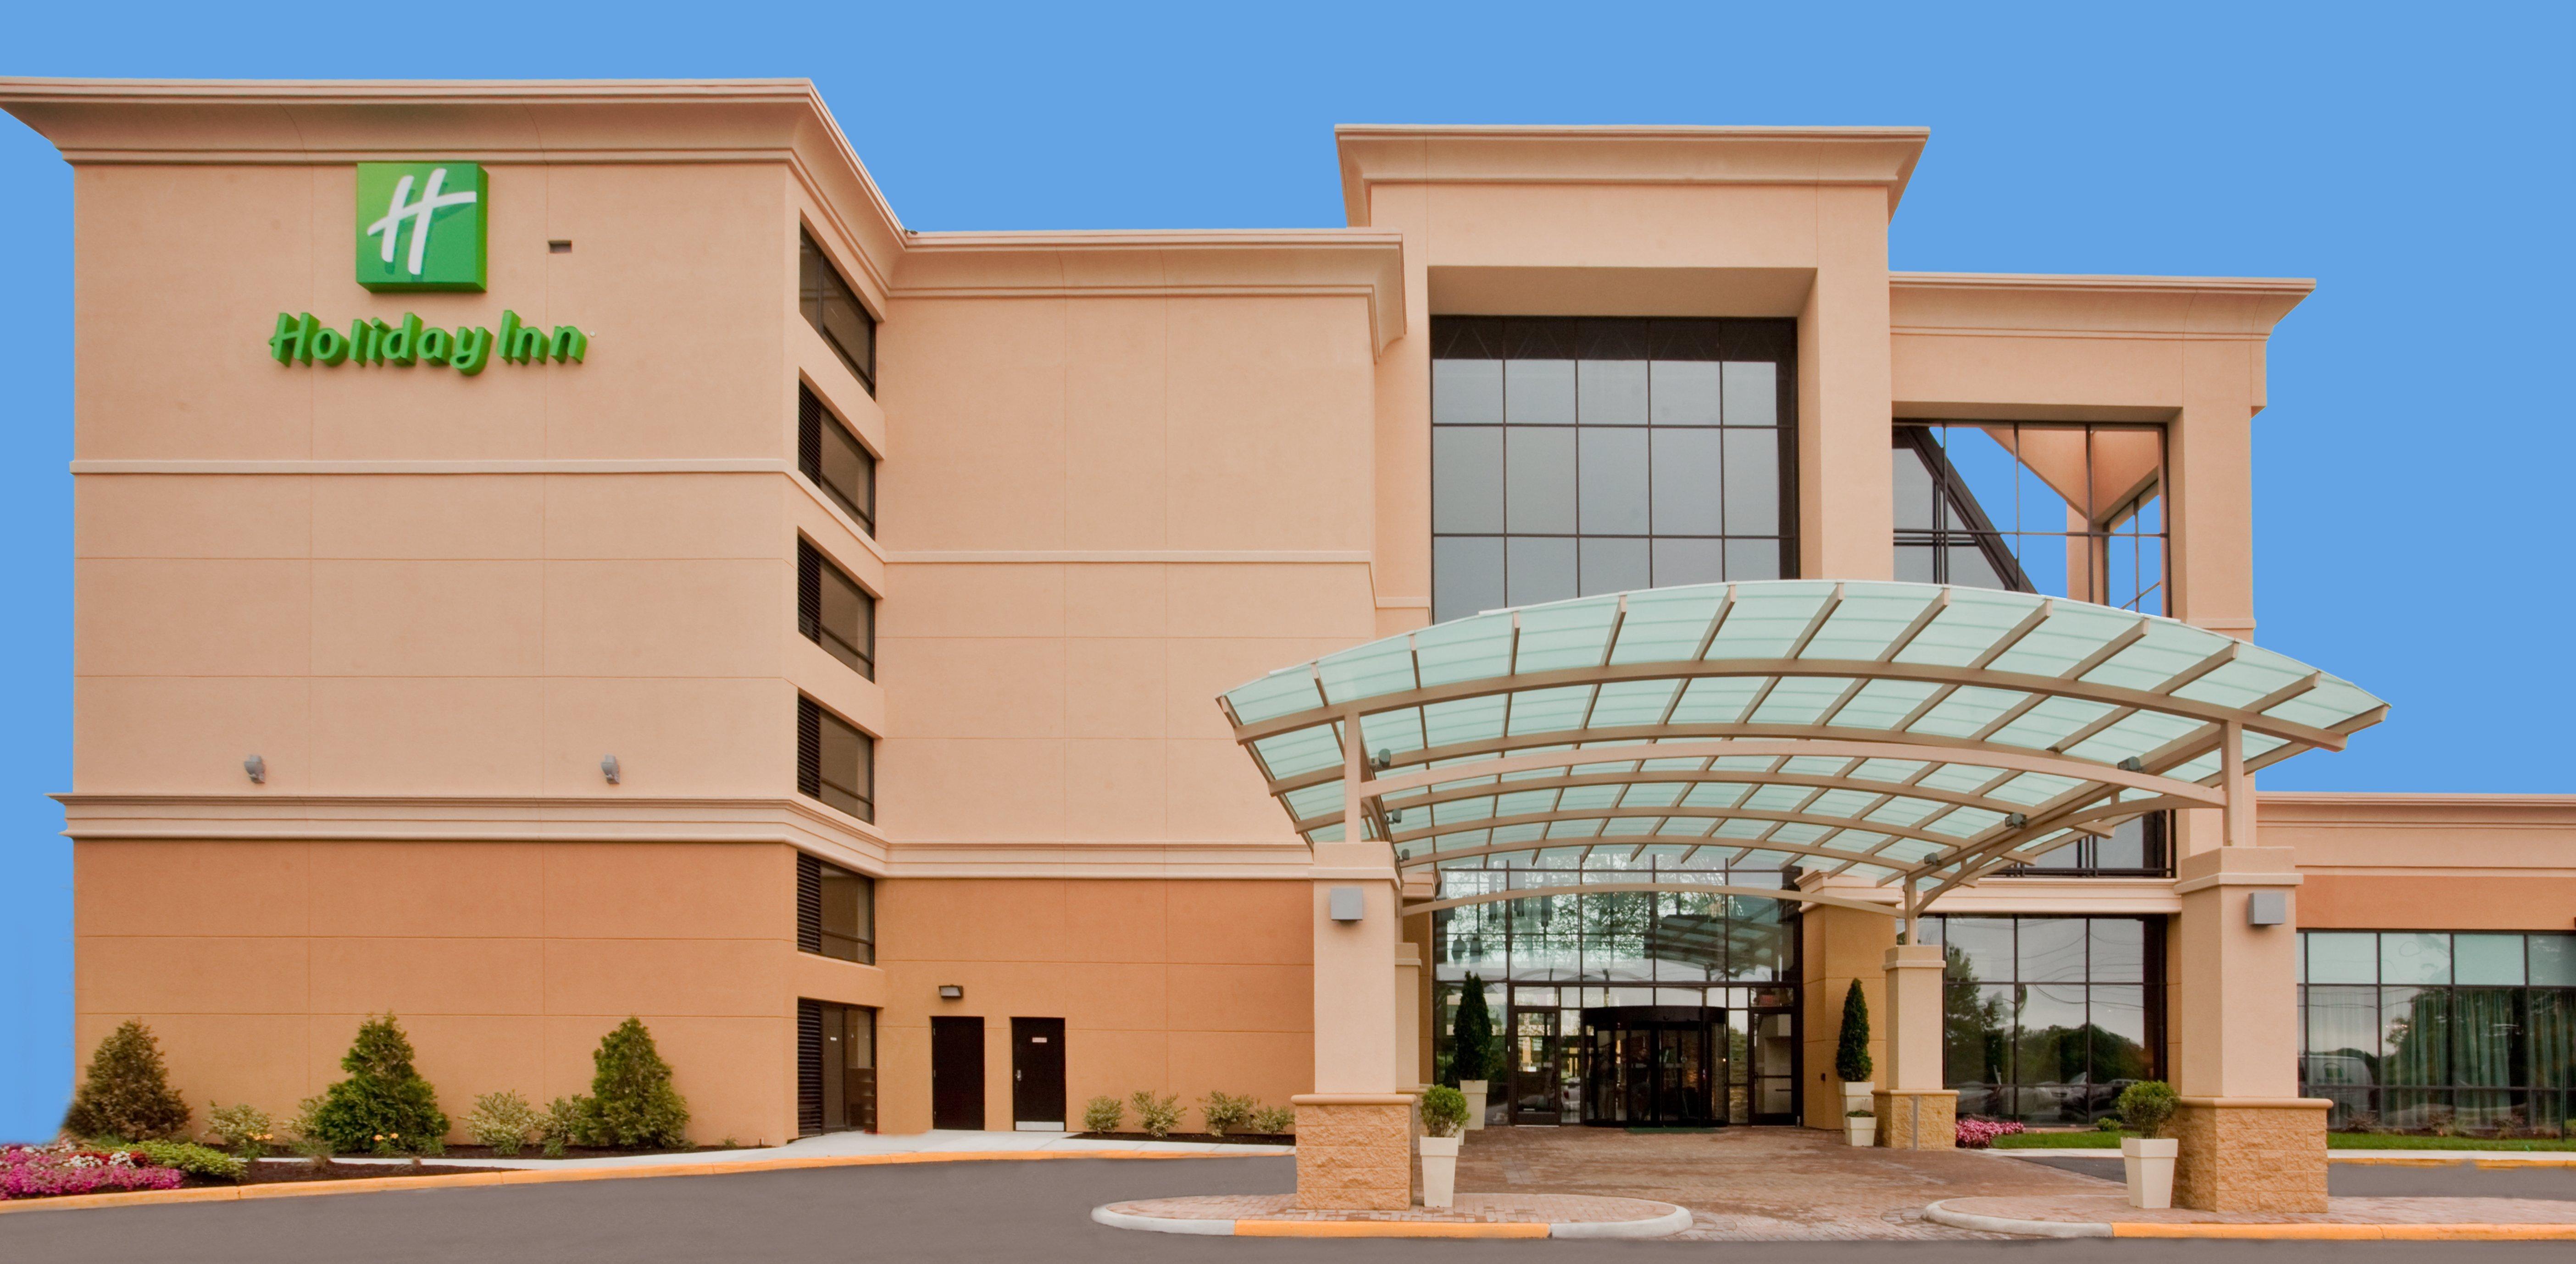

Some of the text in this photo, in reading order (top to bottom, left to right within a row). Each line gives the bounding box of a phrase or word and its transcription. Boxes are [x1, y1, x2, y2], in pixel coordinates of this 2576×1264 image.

[367, 168, 477, 275] H
[269, 310, 588, 376] Holiday Inn
